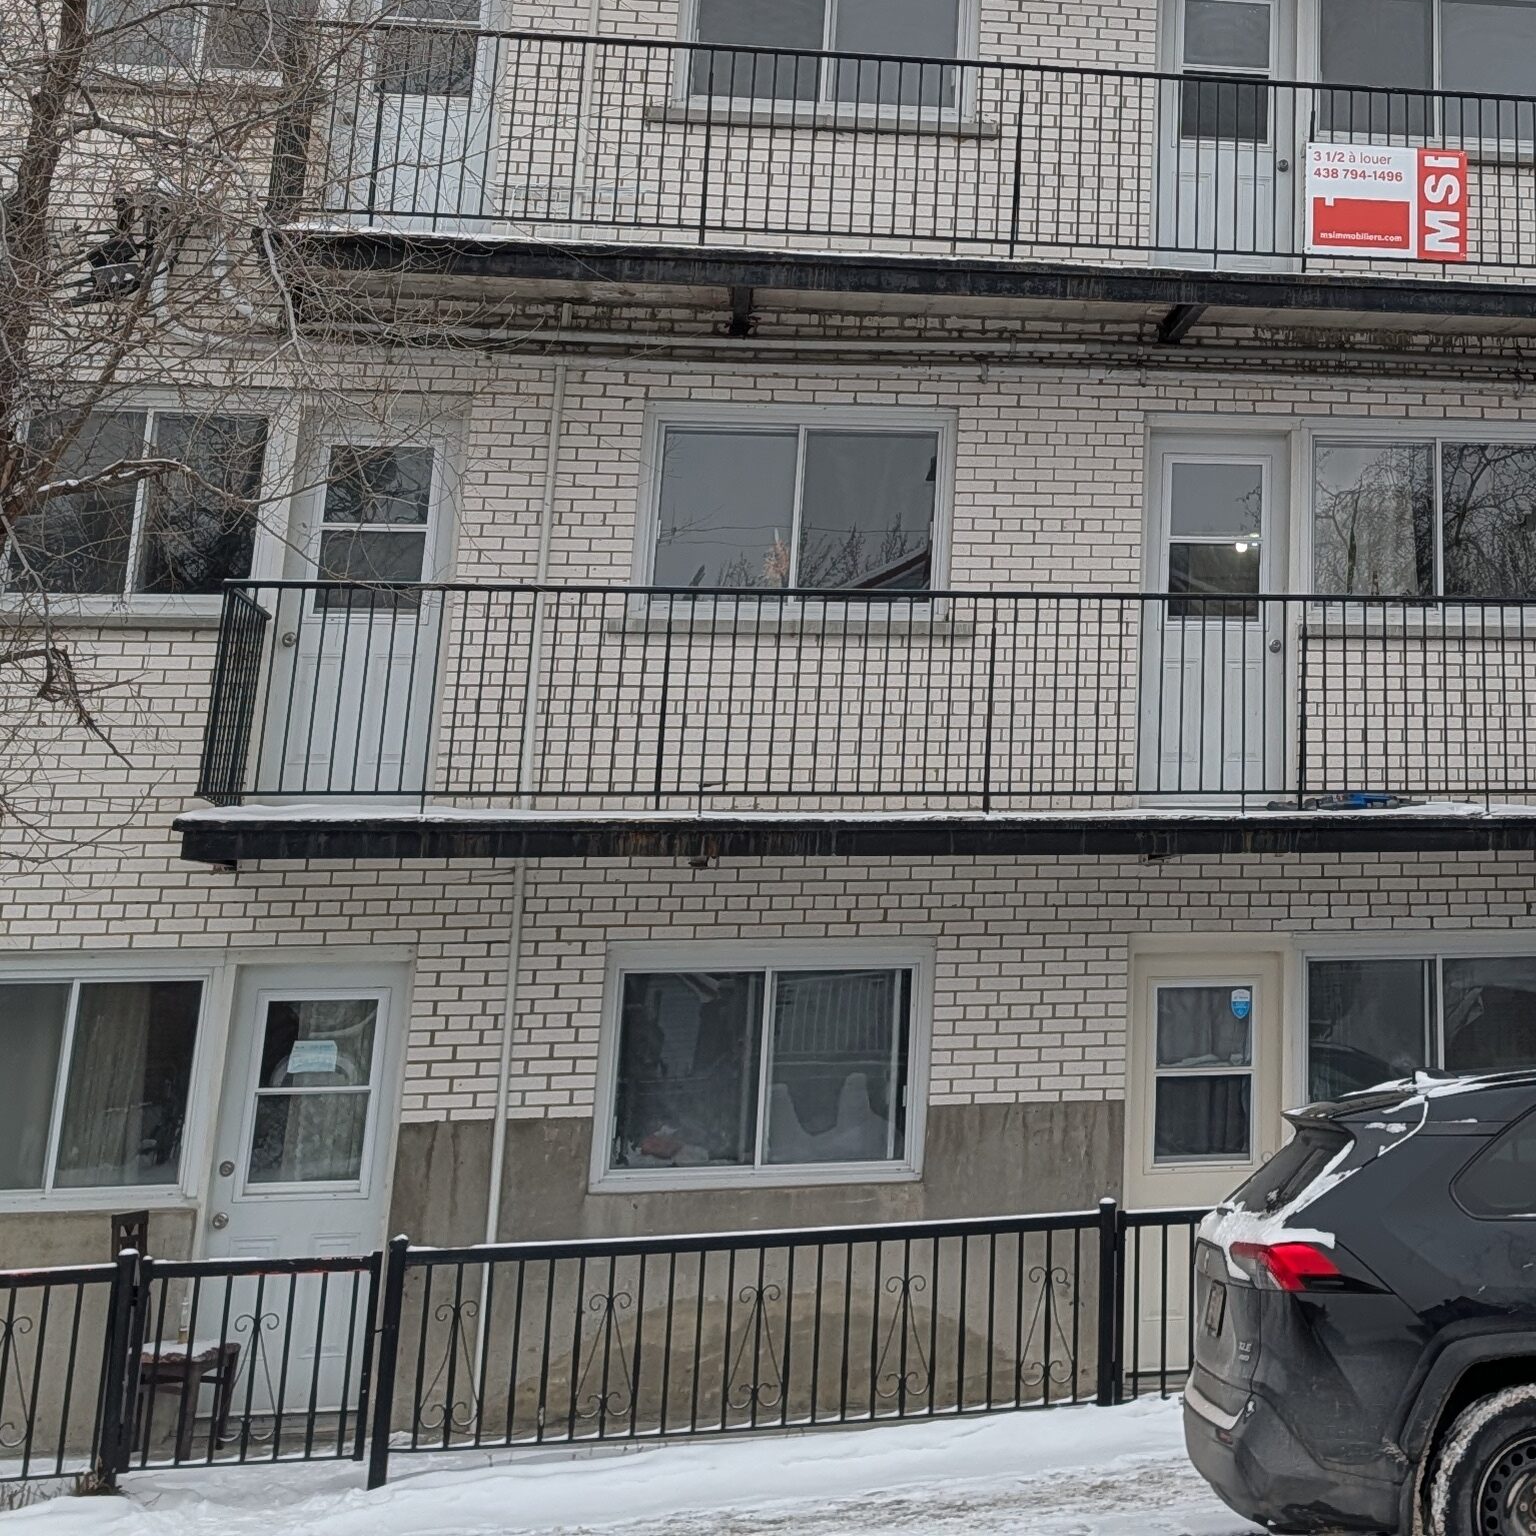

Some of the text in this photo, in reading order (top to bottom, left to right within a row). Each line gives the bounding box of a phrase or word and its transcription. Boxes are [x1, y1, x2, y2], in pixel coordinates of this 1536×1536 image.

[1313, 150, 1392, 165] 3 1/2 à louer
[1313, 167, 1403, 182] 438 794-1496
